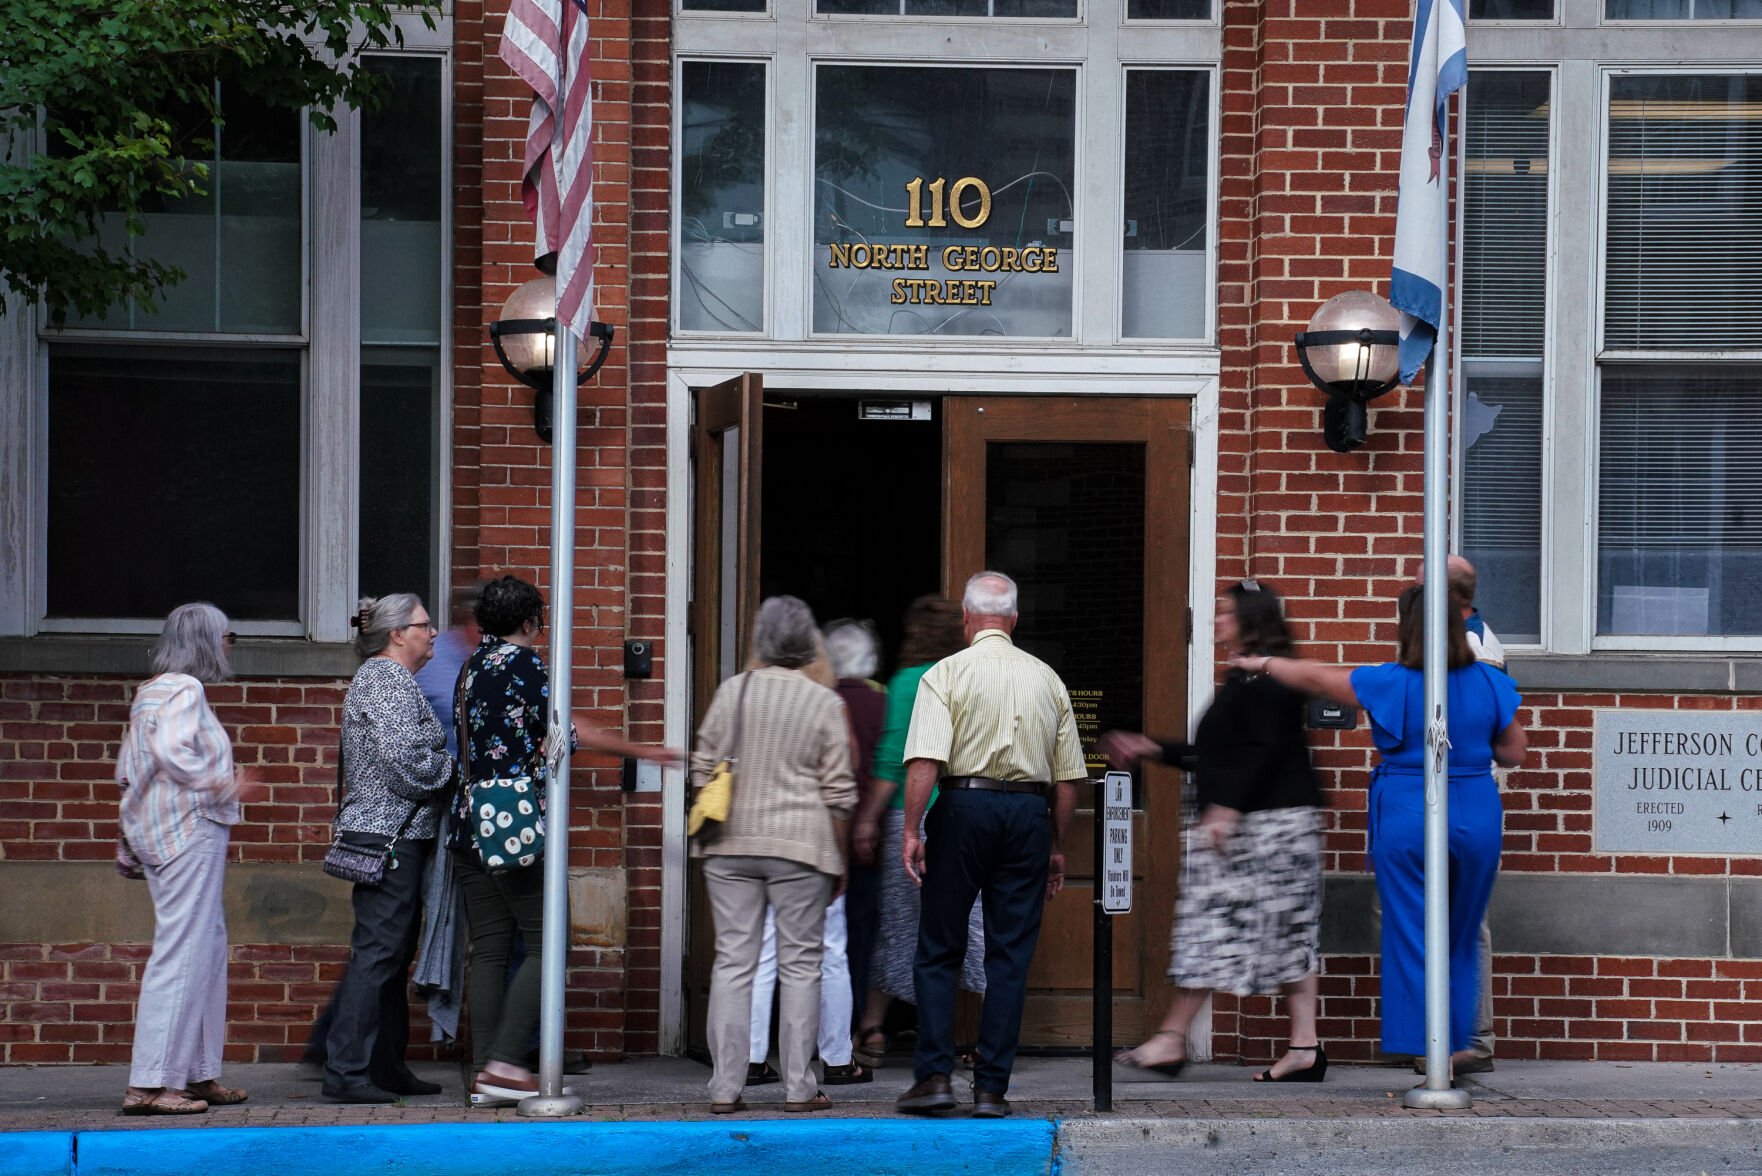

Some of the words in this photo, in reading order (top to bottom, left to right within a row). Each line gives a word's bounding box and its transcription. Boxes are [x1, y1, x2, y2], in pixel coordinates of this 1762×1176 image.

[904, 176, 992, 229] 110
[829, 243, 929, 270] NORTH
[942, 246, 1059, 273] GEORGE
[891, 278, 996, 305] STREET
[1613, 732, 1733, 756] JEFFERSON
[1627, 767, 1731, 791] JUDICIAL
[1106, 806, 1130, 820] ENFORCEMENT
[1636, 802, 1685, 814] ERECTED
[1648, 820, 1672, 831] 1909
[1109, 828, 1127, 844] PARKING
[1114, 848, 1123, 863] ONLY
